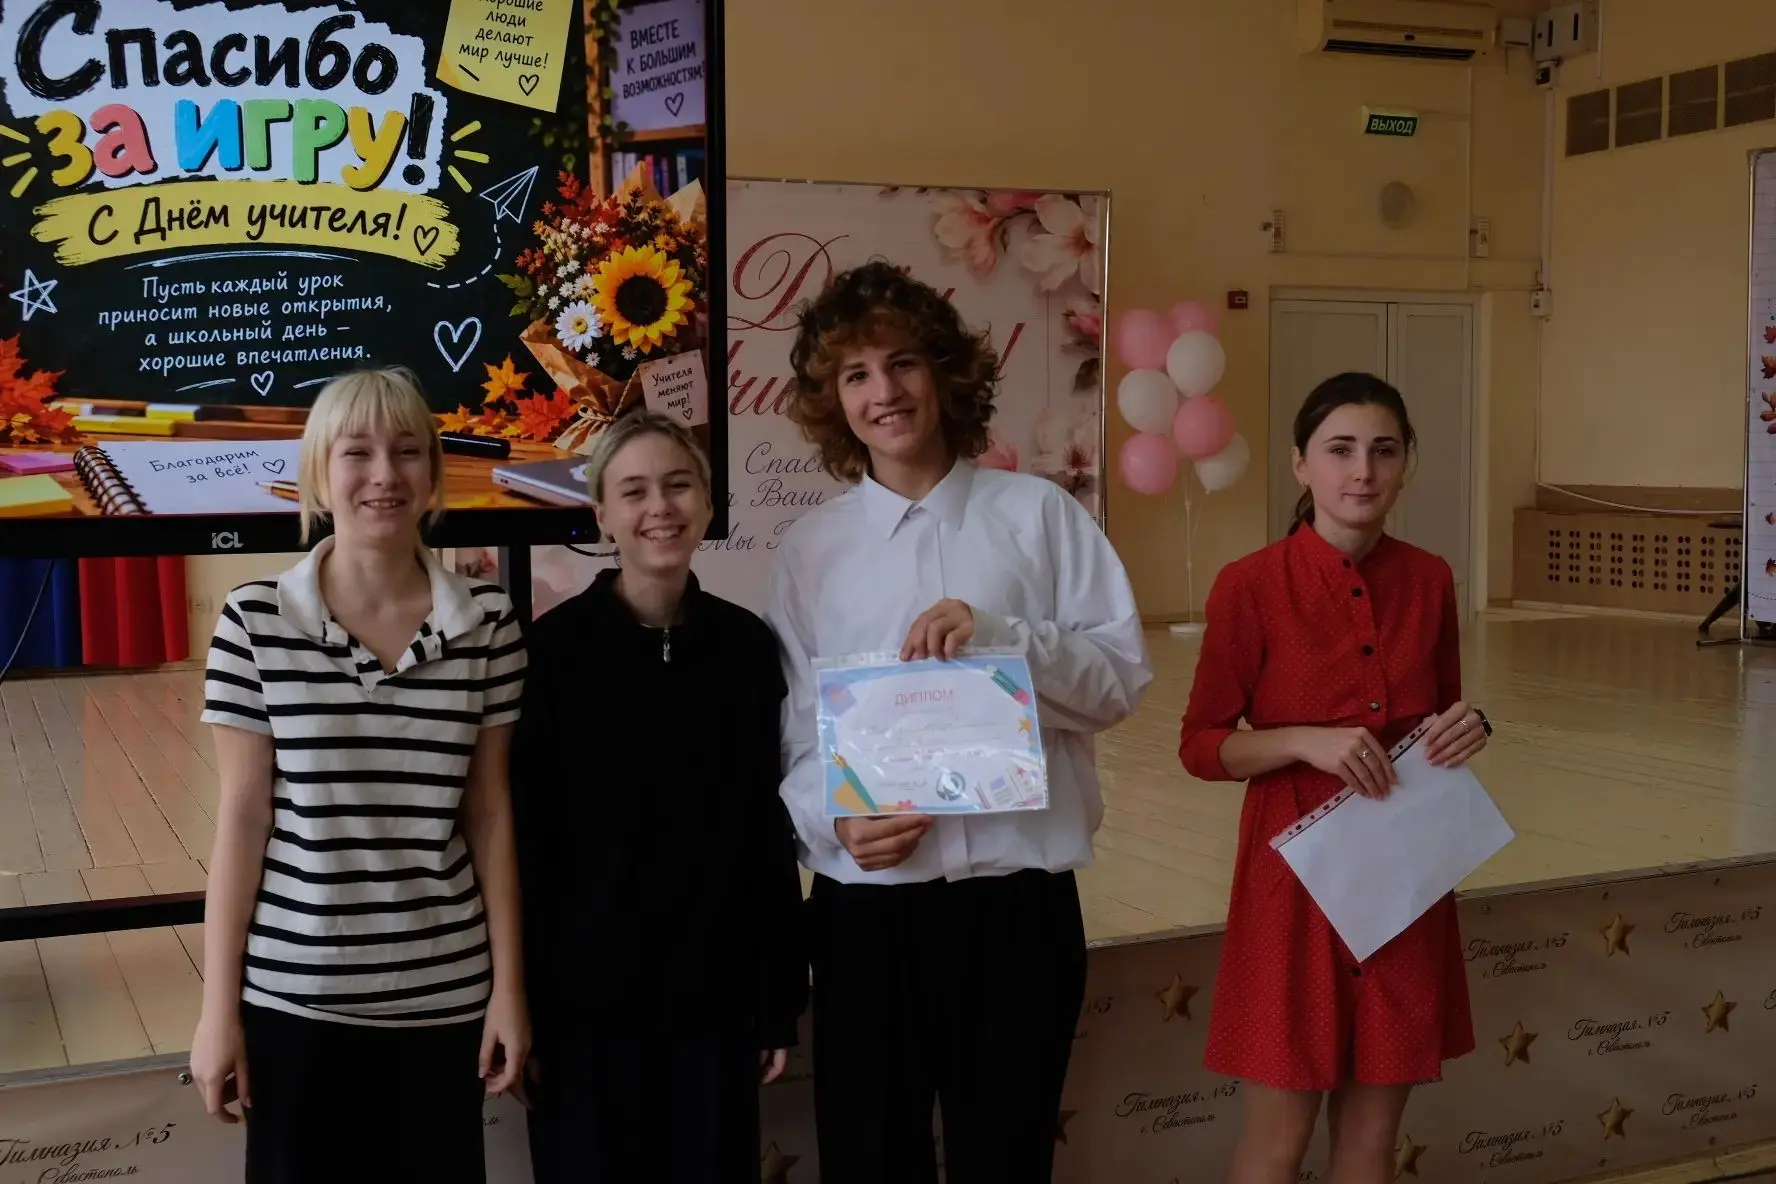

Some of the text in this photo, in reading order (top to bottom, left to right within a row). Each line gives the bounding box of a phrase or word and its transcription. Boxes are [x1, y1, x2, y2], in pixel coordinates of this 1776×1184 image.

[484, 0, 543, 11] рошие
[486, 11, 526, 27] люди
[475, 28, 534, 46] делают
[630, 18, 680, 50] ВМЕСТЕ
[15, 0, 399, 100] Спасибо
[459, 43, 549, 69] мир лучше!
[626, 41, 696, 75] К БОЛЬШИМ
[1370, 118, 1414, 135] ВЫХОД
[34, 103, 159, 188] за
[87, 196, 408, 246] С Днём учителя!
[142, 270, 345, 304] Пусть каждый урок
[98, 295, 393, 331] приносит новые открытия,
[145, 333, 158, 347] а
[168, 320, 272, 345] школьный
[281, 321, 328, 342] день
[139, 345, 372, 377] хорошие впечатления.
[652, 367, 693, 387] Учителя
[657, 380, 694, 398] меняют
[667, 392, 691, 410] мир!
[149, 450, 260, 472] Благодарим
[186, 463, 251, 483] за всё!
[894, 687, 954, 707] ДИПЛОМ
[1115, 1091, 1200, 1118] Гимназия
[0, 1122, 178, 1168] Гимназия №5
